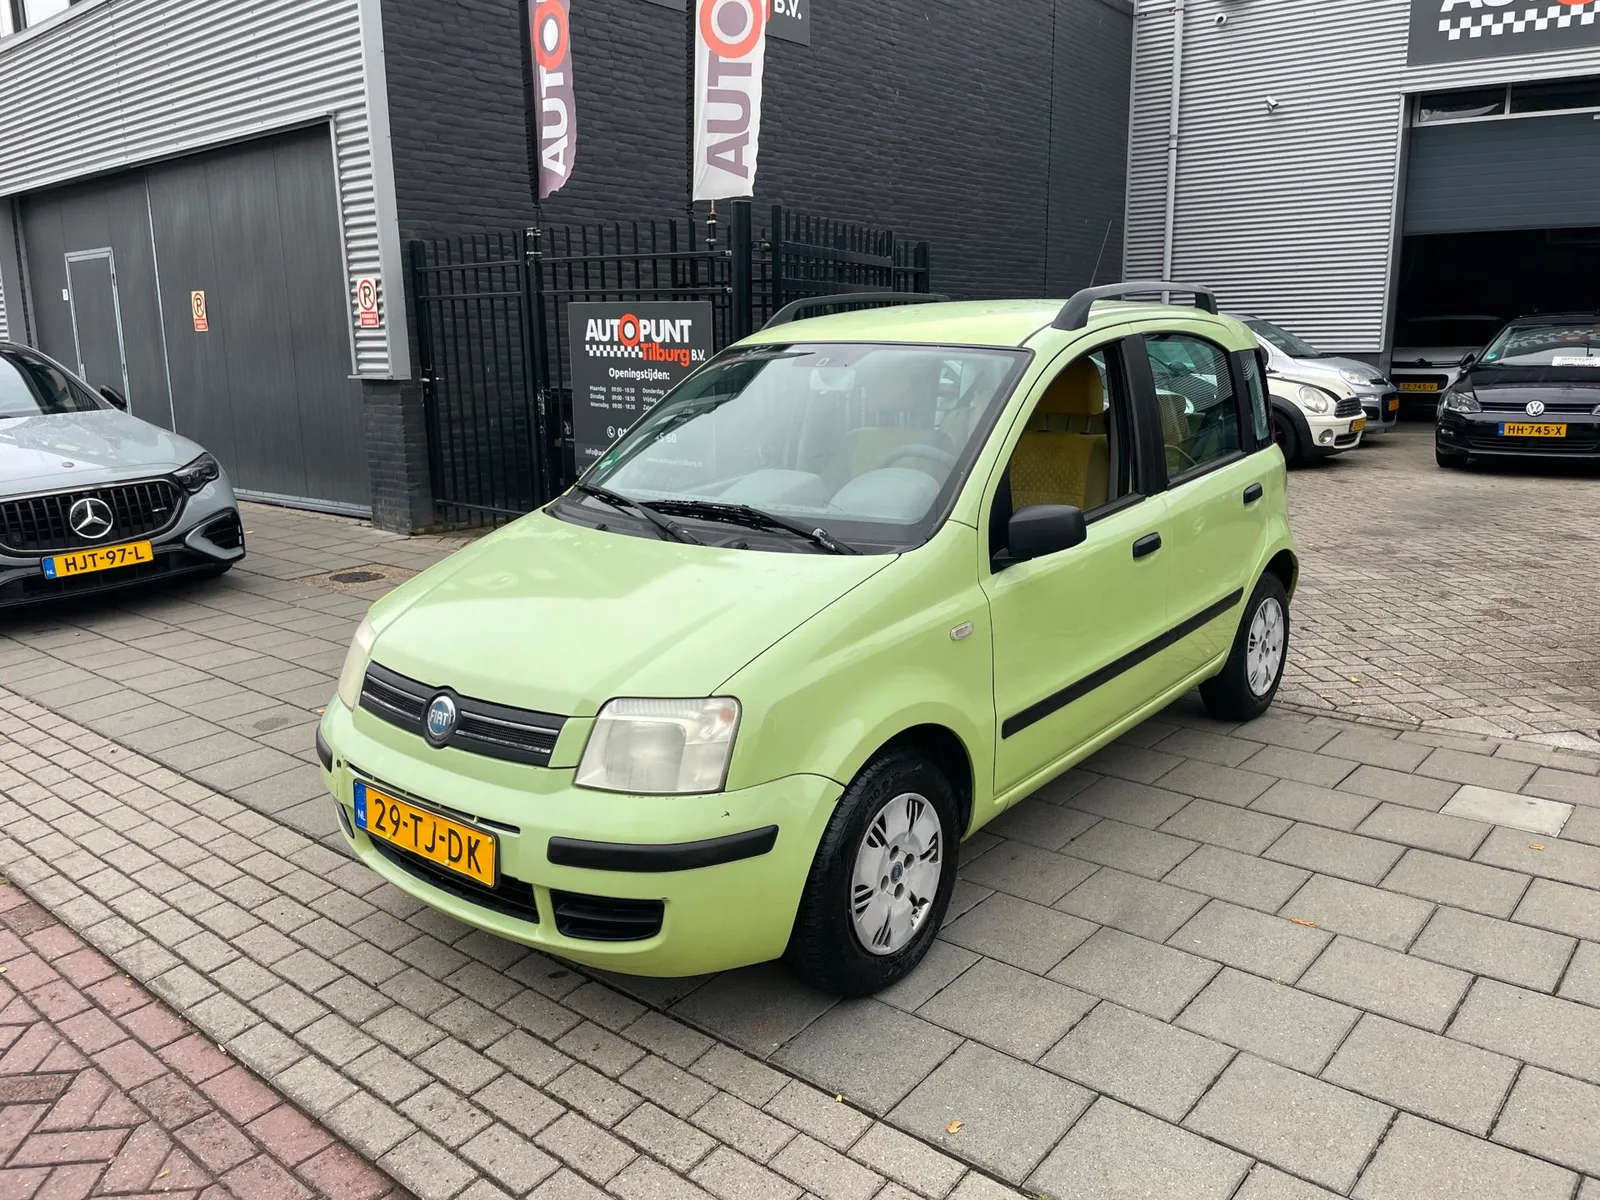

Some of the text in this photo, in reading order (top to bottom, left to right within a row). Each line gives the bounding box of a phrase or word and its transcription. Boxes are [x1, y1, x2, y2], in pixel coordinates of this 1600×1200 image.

[533, 0, 568, 177] AUTO
[585, 313, 692, 347] AUTOPUNT
[641, 342, 706, 367] Tilburg B.V.
[608, 367, 670, 381] Openingstijden:
[1507, 425, 1562, 435] HH-745-X
[64, 546, 144, 572] HJT-97-L
[430, 708, 449, 726] FIAT
[357, 798, 482, 874] NL 29-TJ-DK
